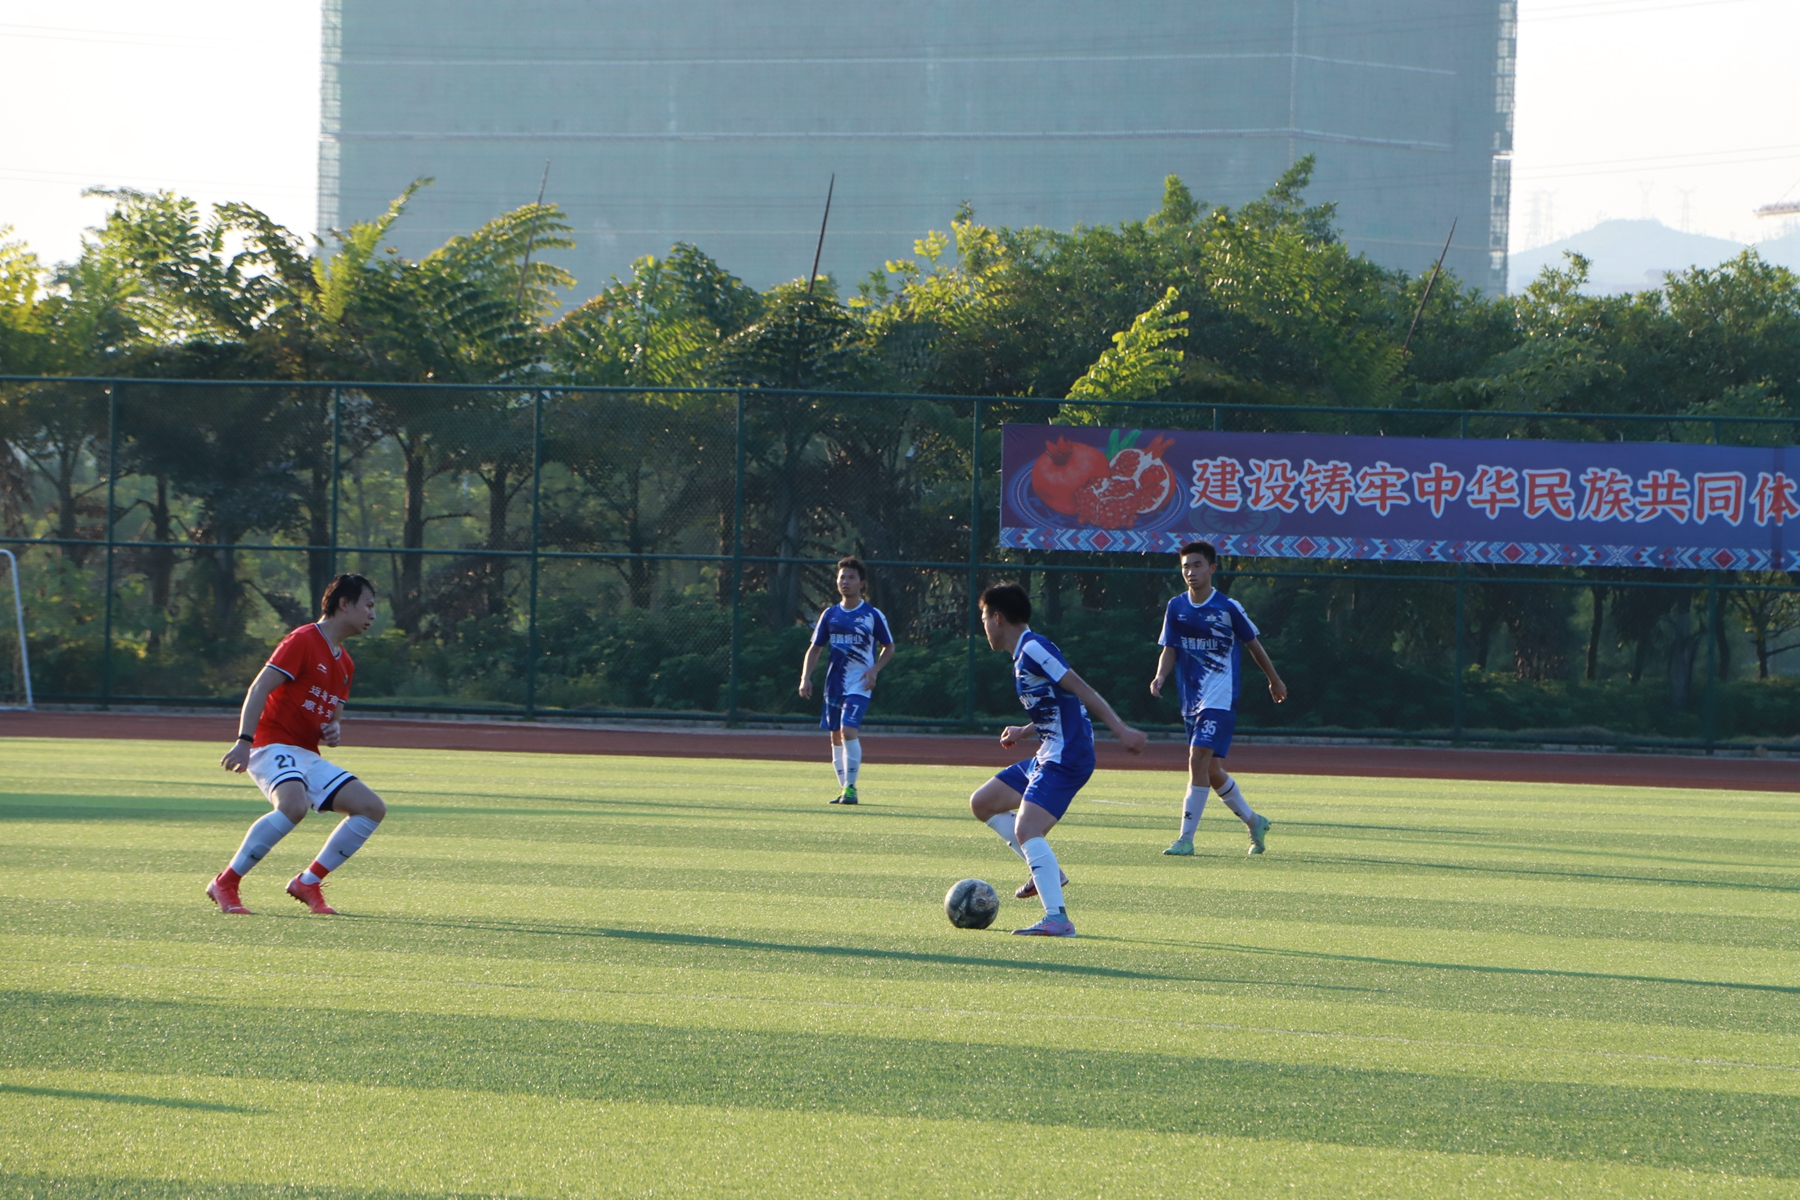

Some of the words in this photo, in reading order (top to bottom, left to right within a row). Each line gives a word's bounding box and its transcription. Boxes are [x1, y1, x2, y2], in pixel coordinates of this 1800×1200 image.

[1189, 456, 1800, 527] 建设铸牢中华民族共同体
[851, 704, 859, 717] 7
[1201, 719, 1217, 736] 35
[275, 754, 296, 769] 27
